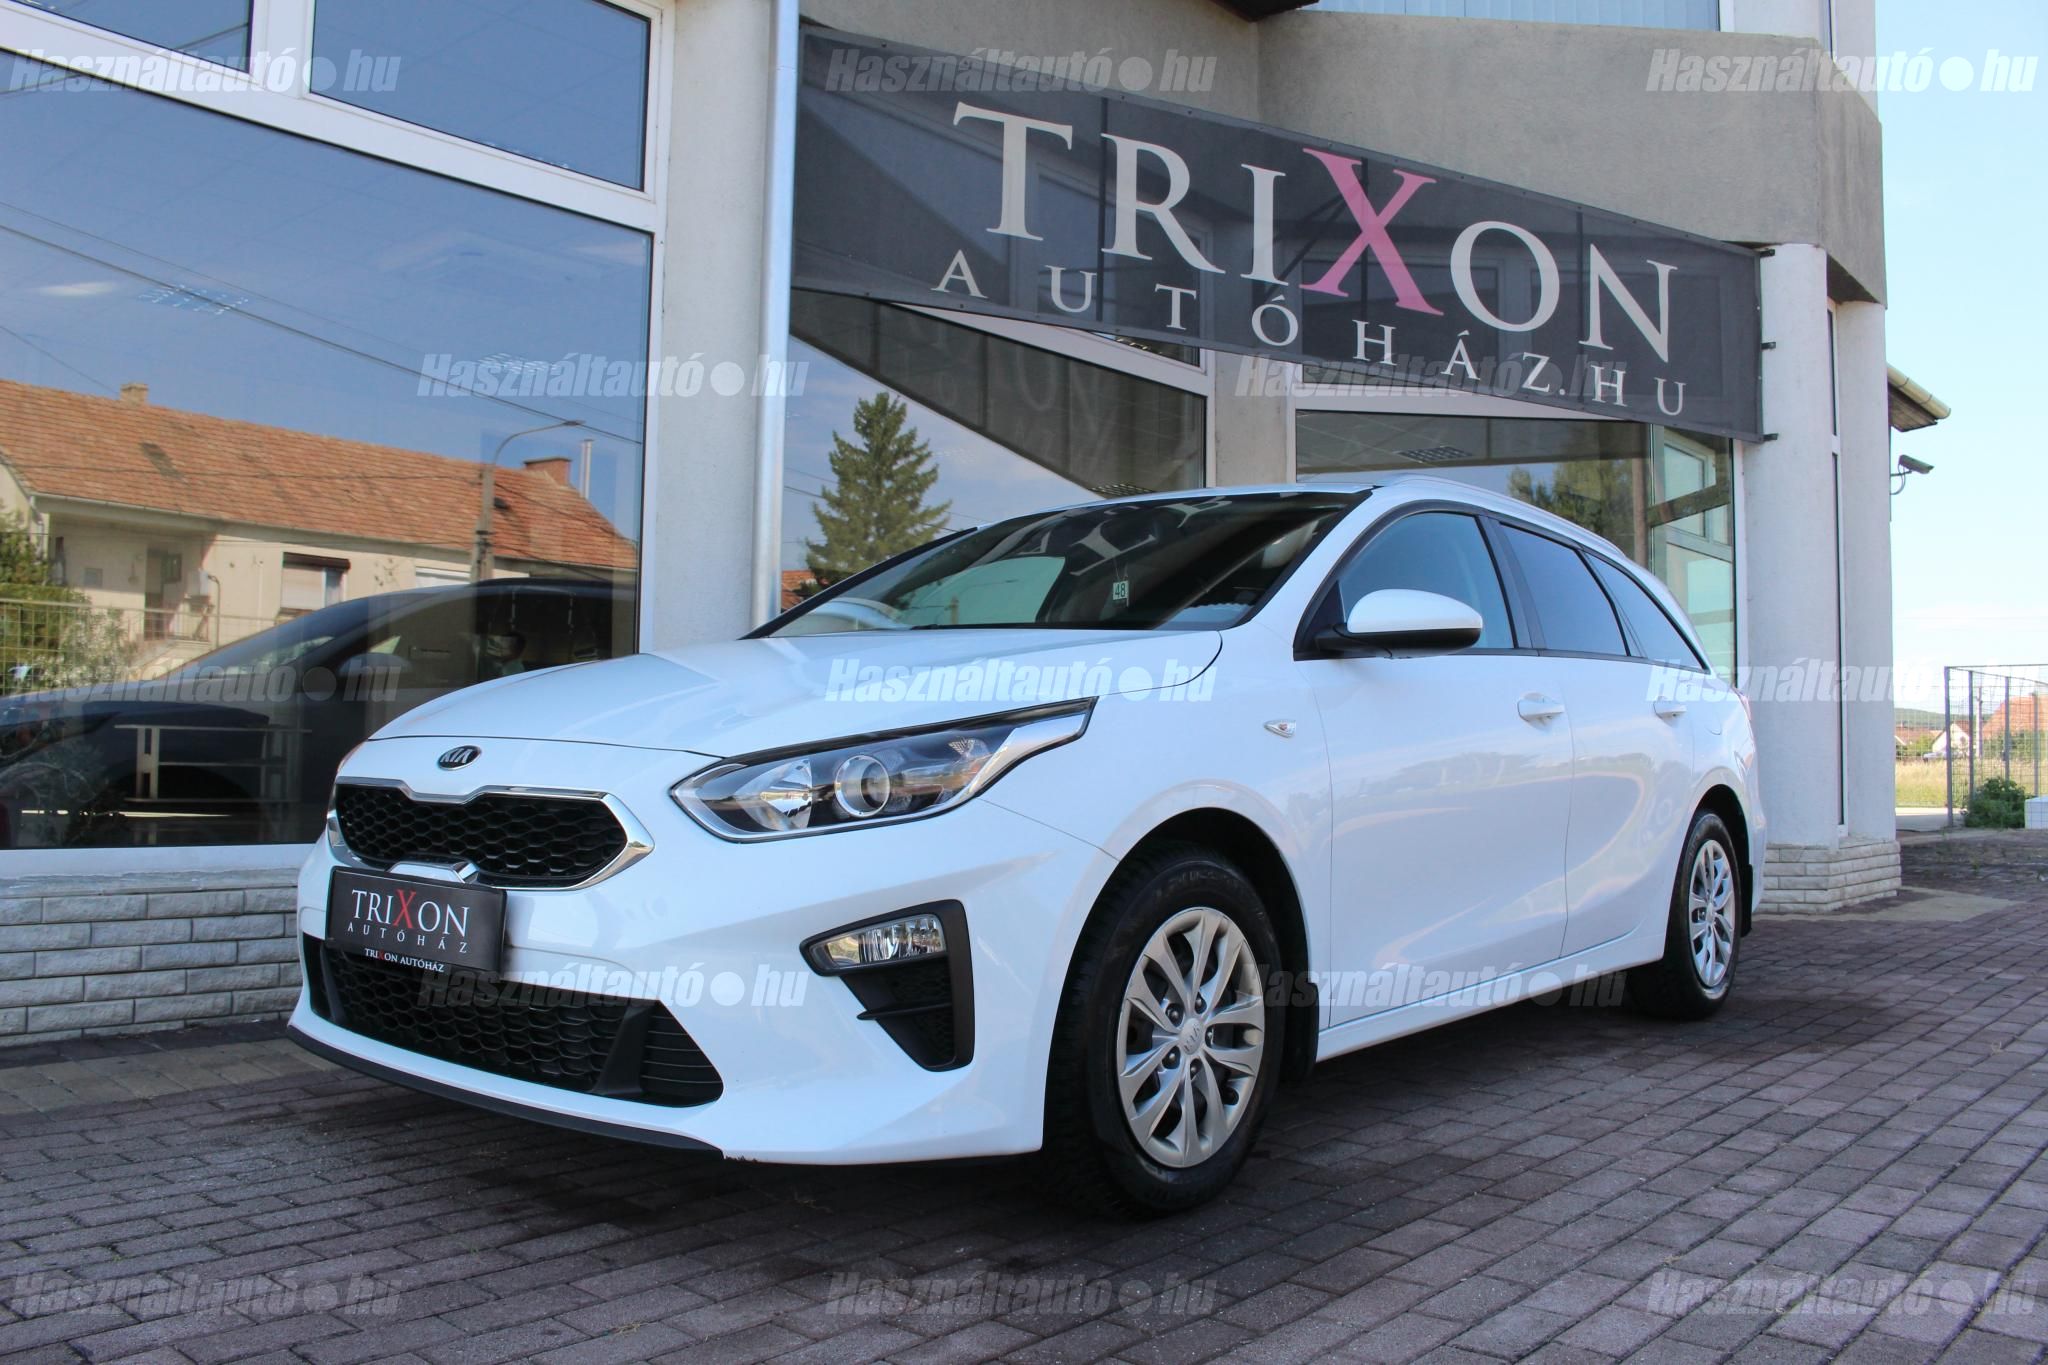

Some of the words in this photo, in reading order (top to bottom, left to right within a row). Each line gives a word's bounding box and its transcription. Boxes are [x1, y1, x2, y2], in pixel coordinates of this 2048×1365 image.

[953, 101, 1677, 362] TRIXON
[1114, 583, 1126, 599] 48
[439, 748, 473, 763] KIA
[352, 889, 470, 937] TRIXON
[347, 922, 467, 954] AUTÓHÁZ
[365, 948, 398, 963] TRIXON
[400, 955, 445, 973] AUTÓHÁZ
